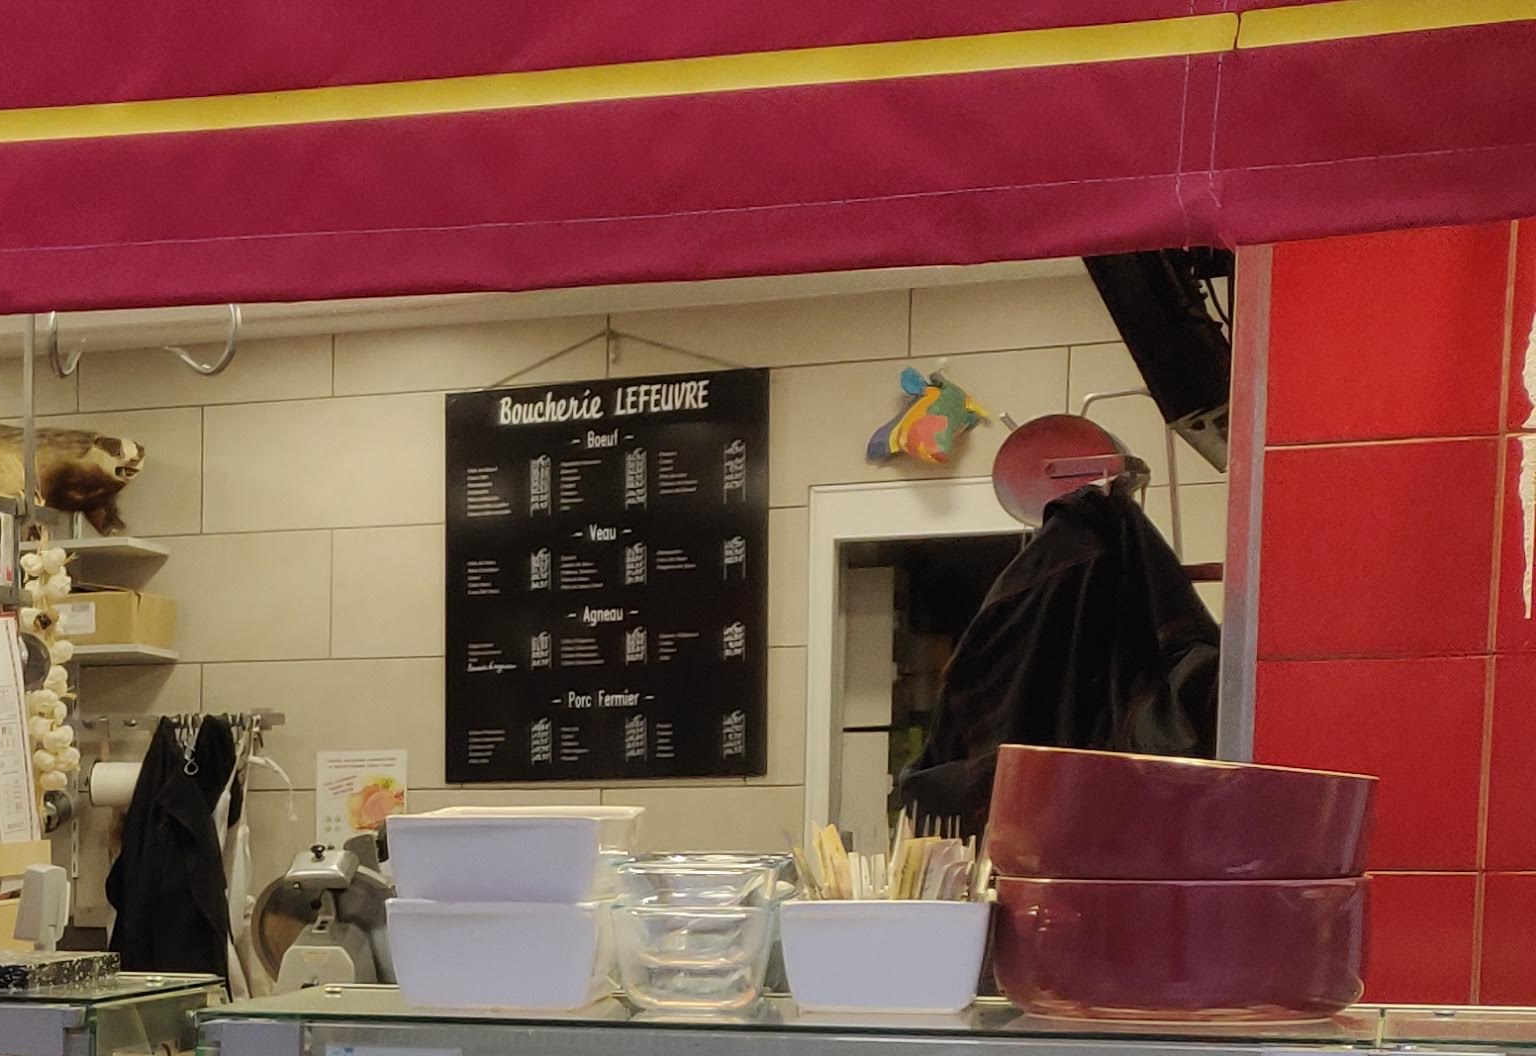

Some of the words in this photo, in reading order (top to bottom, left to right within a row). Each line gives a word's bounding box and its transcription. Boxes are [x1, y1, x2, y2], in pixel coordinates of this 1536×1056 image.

[499, 388, 604, 425] Boucherie
[613, 379, 710, 417] LEFEUVRE
[587, 430, 618, 448] Boeuf
[589, 524, 617, 541] Veau
[583, 605, 624, 625] Agneau
[568, 691, 592, 708] Porc
[598, 690, 639, 708] Fermier
